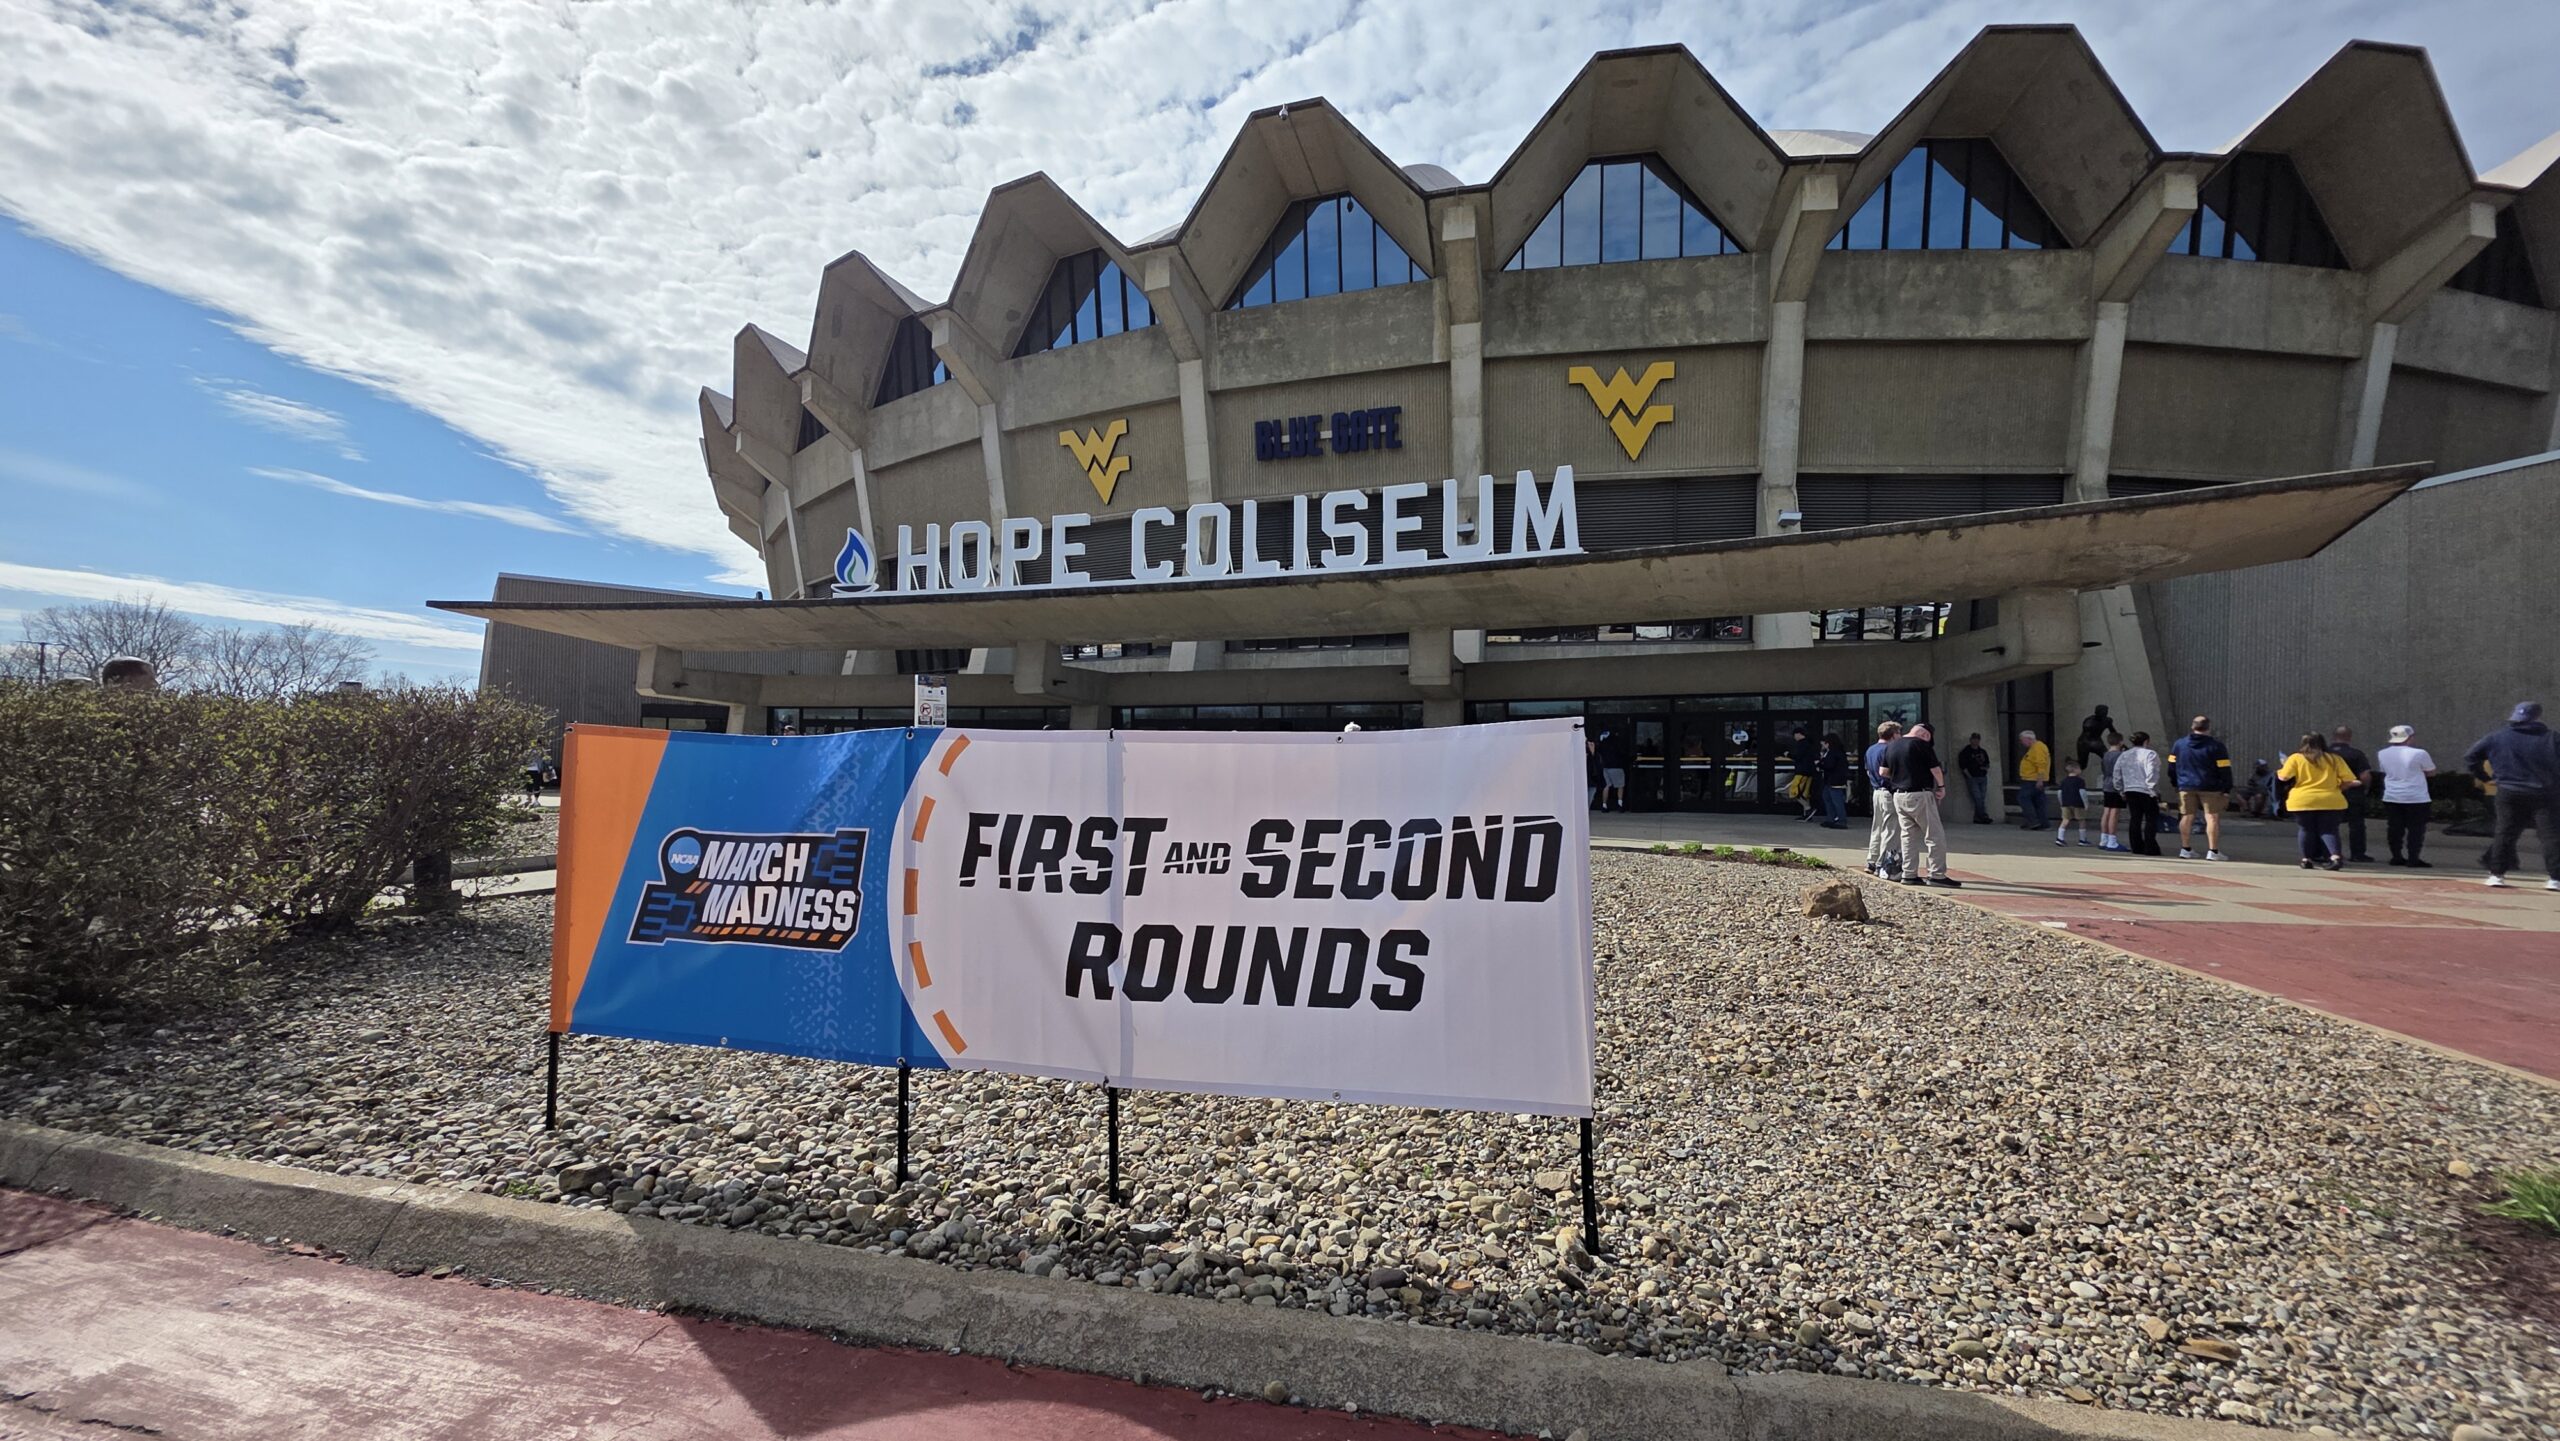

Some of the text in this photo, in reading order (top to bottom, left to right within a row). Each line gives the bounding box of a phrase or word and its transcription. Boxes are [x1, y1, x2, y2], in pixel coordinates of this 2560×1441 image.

[1255, 405, 1403, 461] BLUE GATE
[896, 464, 1581, 592] HOPE COLISEUM
[670, 853, 700, 865] NCAA
[698, 840, 810, 883] MARCH
[959, 812, 1564, 903] FIRST AND SECOND
[701, 884, 856, 932] MADNESS
[1065, 921, 1431, 1012] ROUNDS
